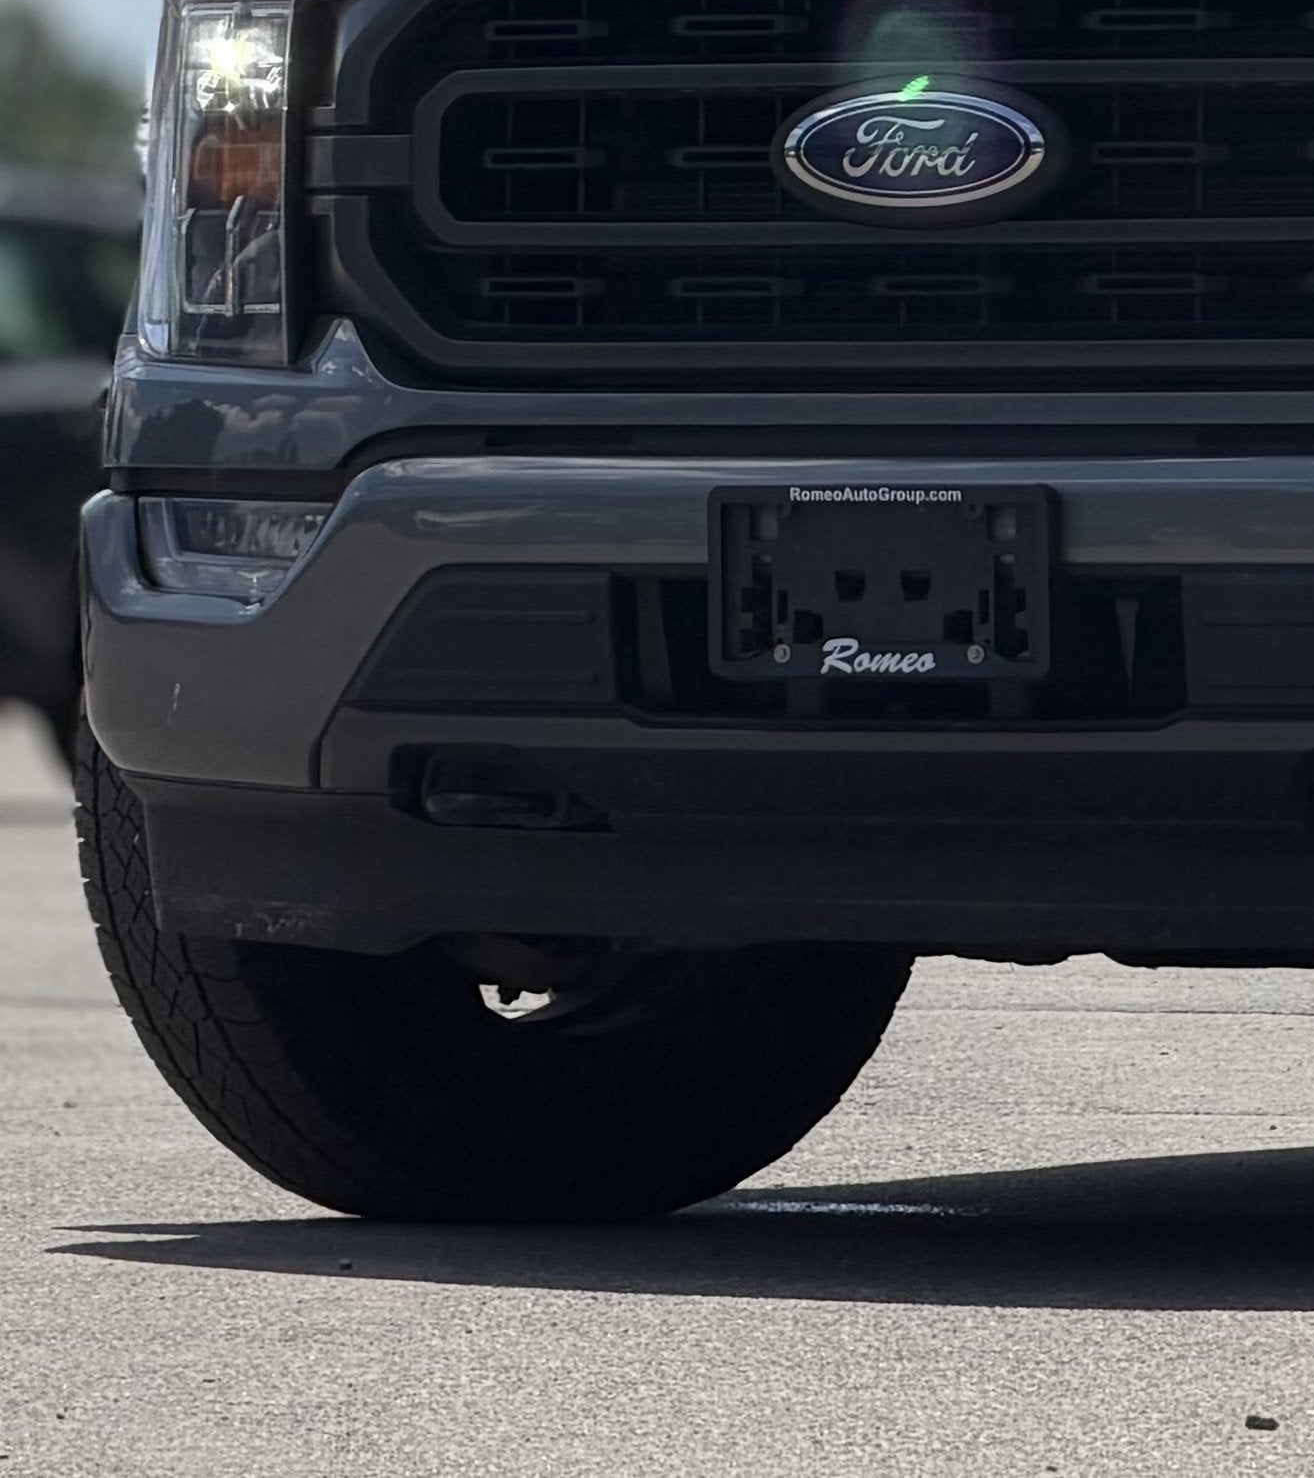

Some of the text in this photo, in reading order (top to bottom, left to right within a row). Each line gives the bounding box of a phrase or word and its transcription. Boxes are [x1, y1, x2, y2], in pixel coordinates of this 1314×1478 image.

[842, 115, 980, 178] Ford
[788, 486, 963, 506] RomeoAutoGroup.com
[820, 637, 937, 675] Romeo
